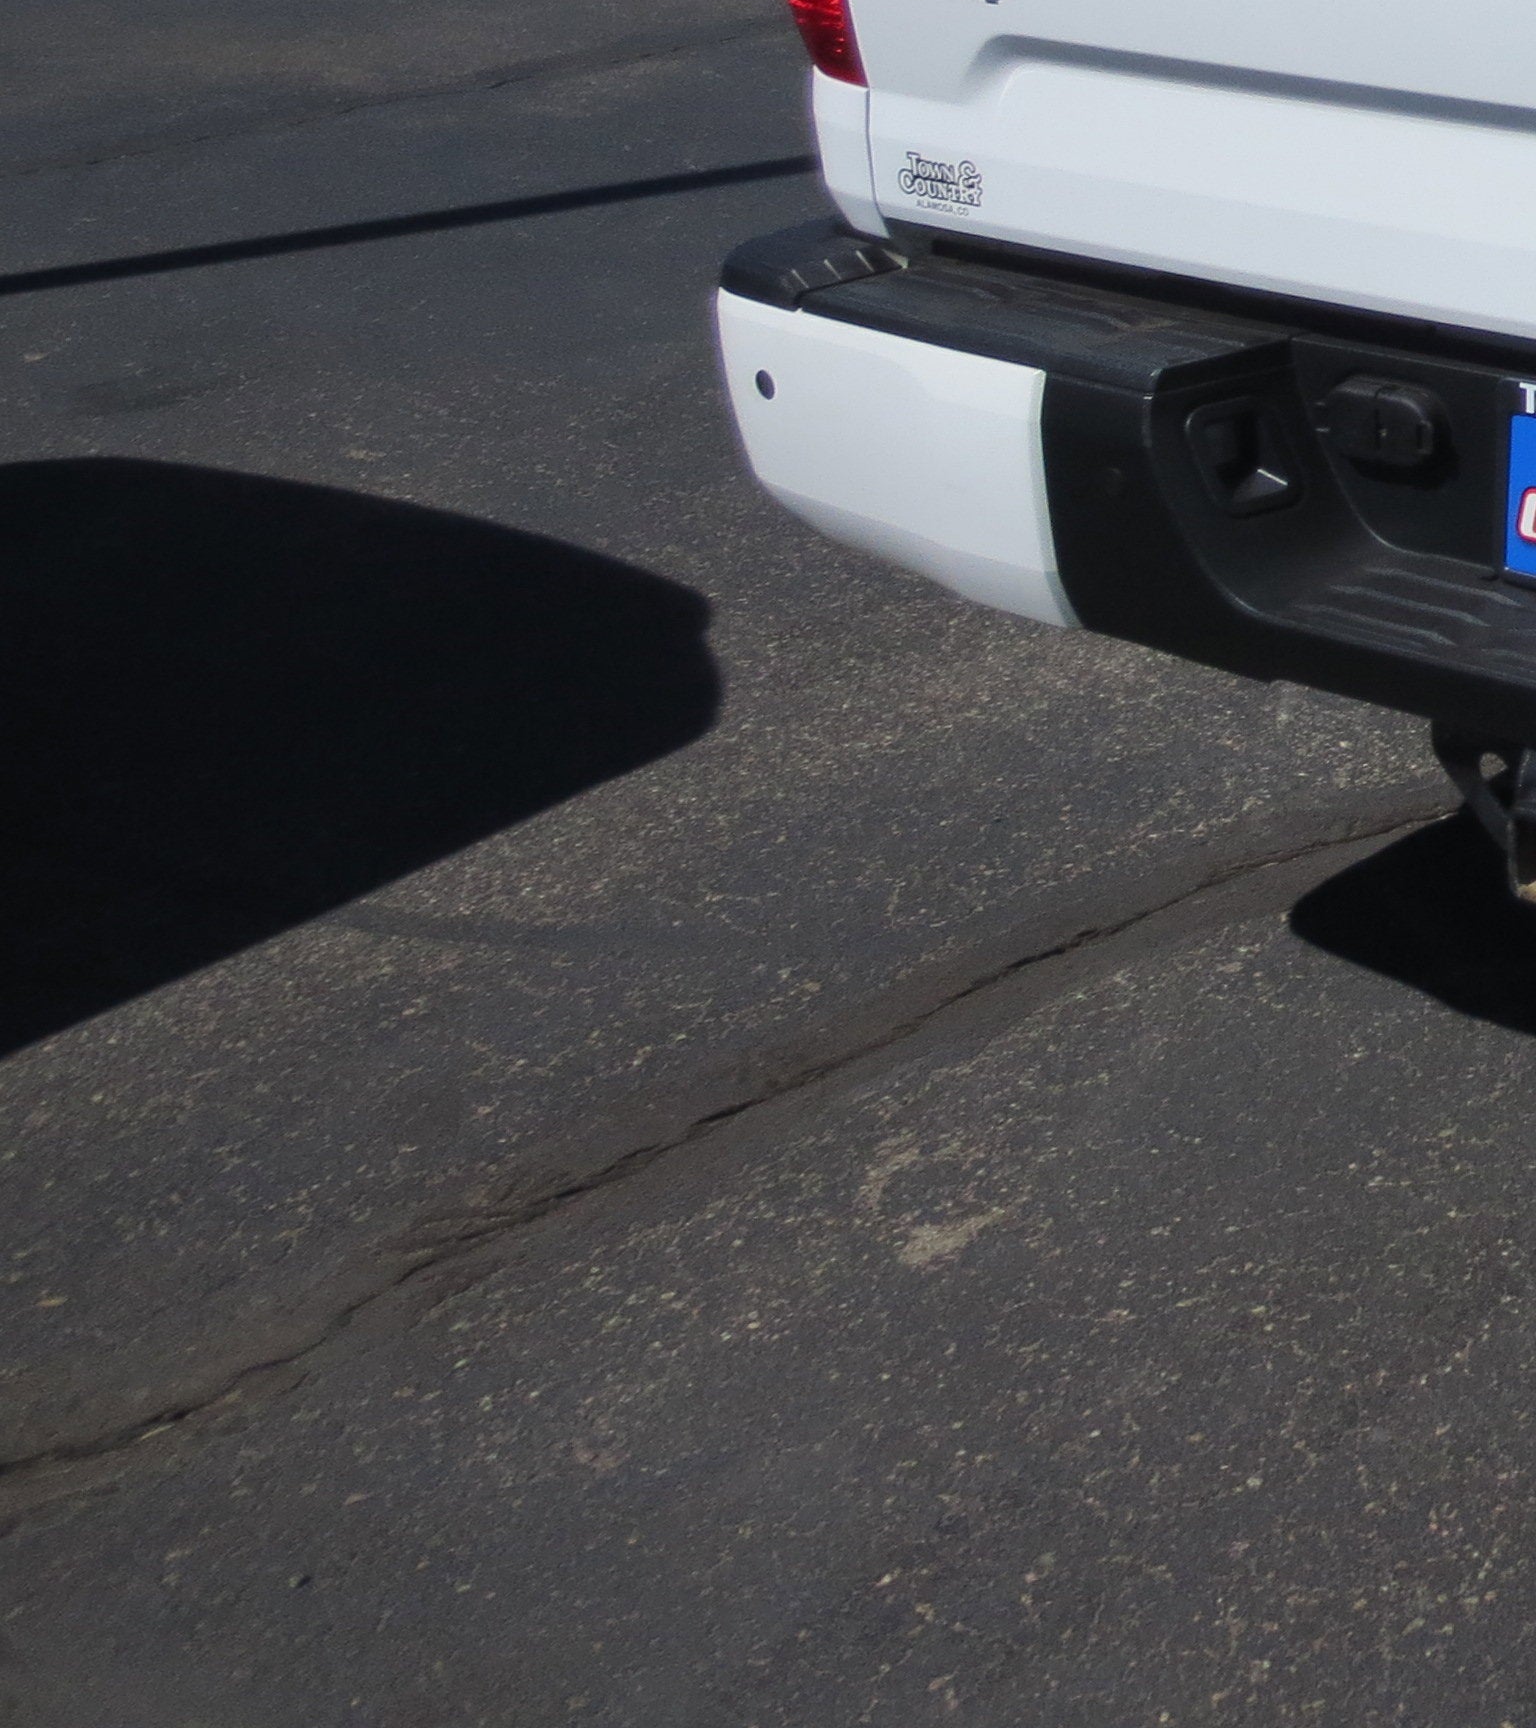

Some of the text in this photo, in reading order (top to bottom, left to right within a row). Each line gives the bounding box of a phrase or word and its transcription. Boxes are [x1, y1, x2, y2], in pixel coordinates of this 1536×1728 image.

[898, 167, 983, 206] COUNTRY
[906, 151, 982, 189] TOWN &
